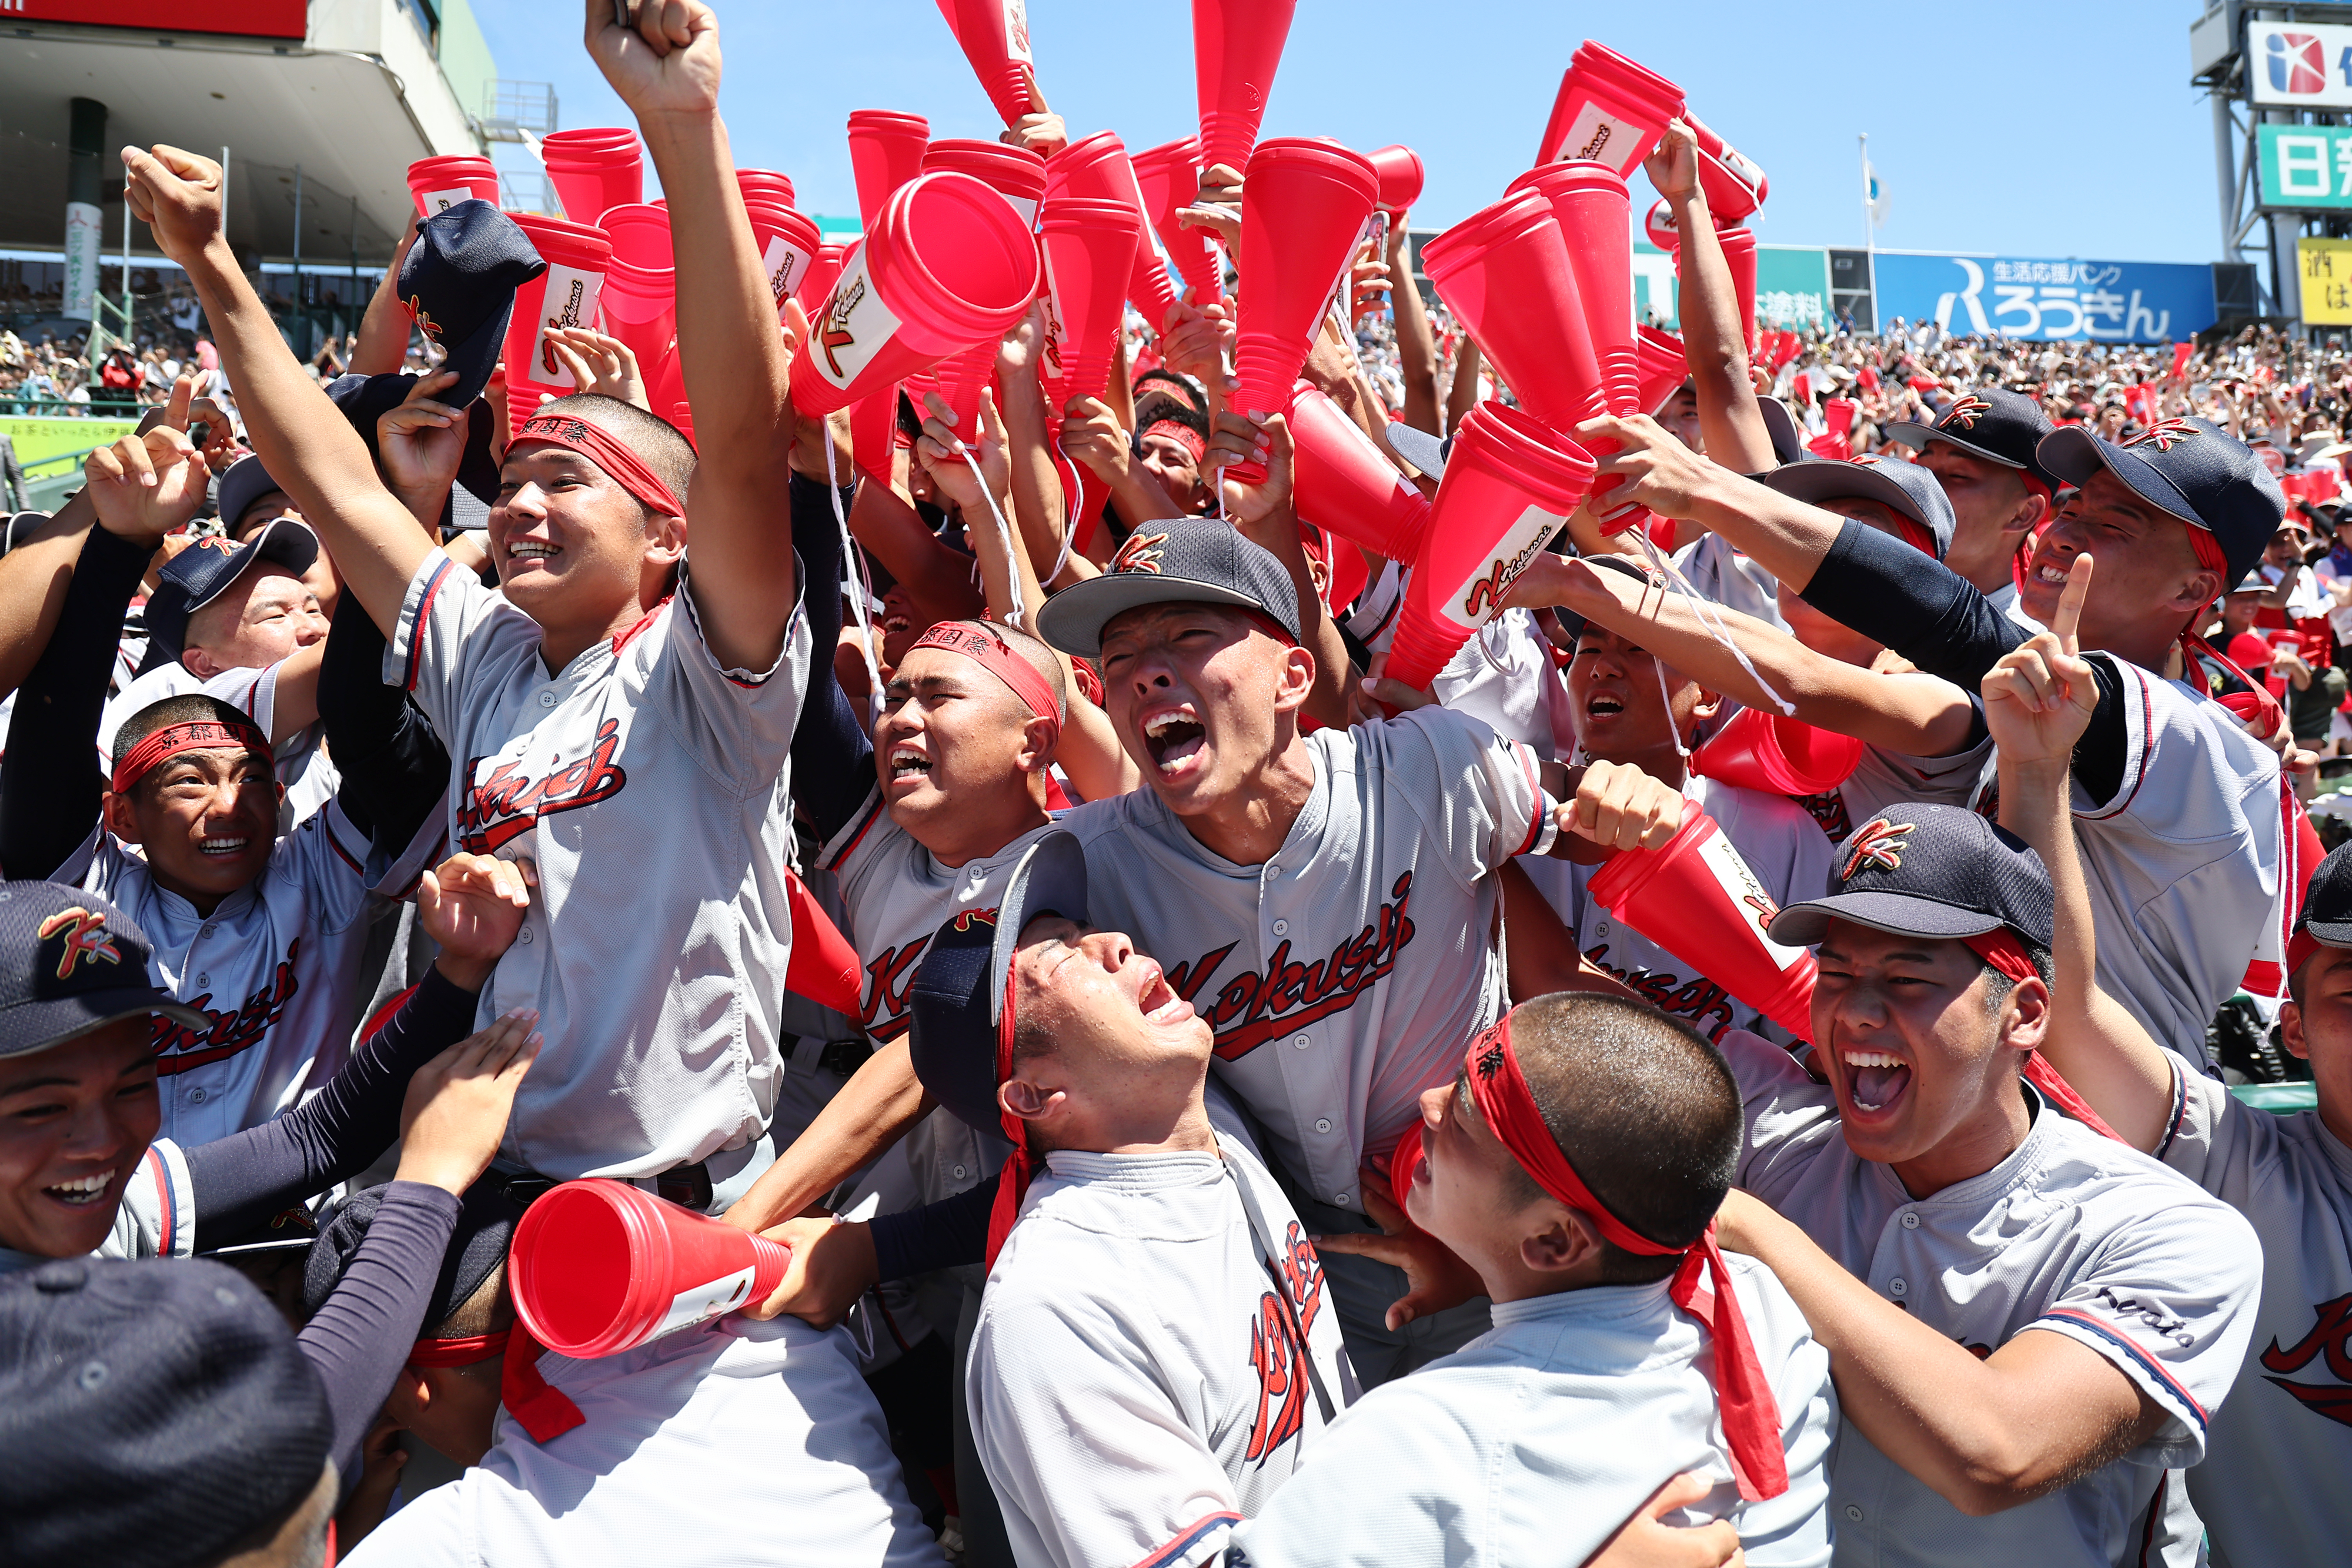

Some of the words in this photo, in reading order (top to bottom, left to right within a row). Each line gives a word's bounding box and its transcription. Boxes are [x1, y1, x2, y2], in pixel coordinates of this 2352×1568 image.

[2276, 135, 2352, 198] 日
[1993, 260, 2122, 286] 生活応援バンク
[1994, 285, 2170, 340] ろうきん
[1500, 524, 1552, 582] Kokusai
